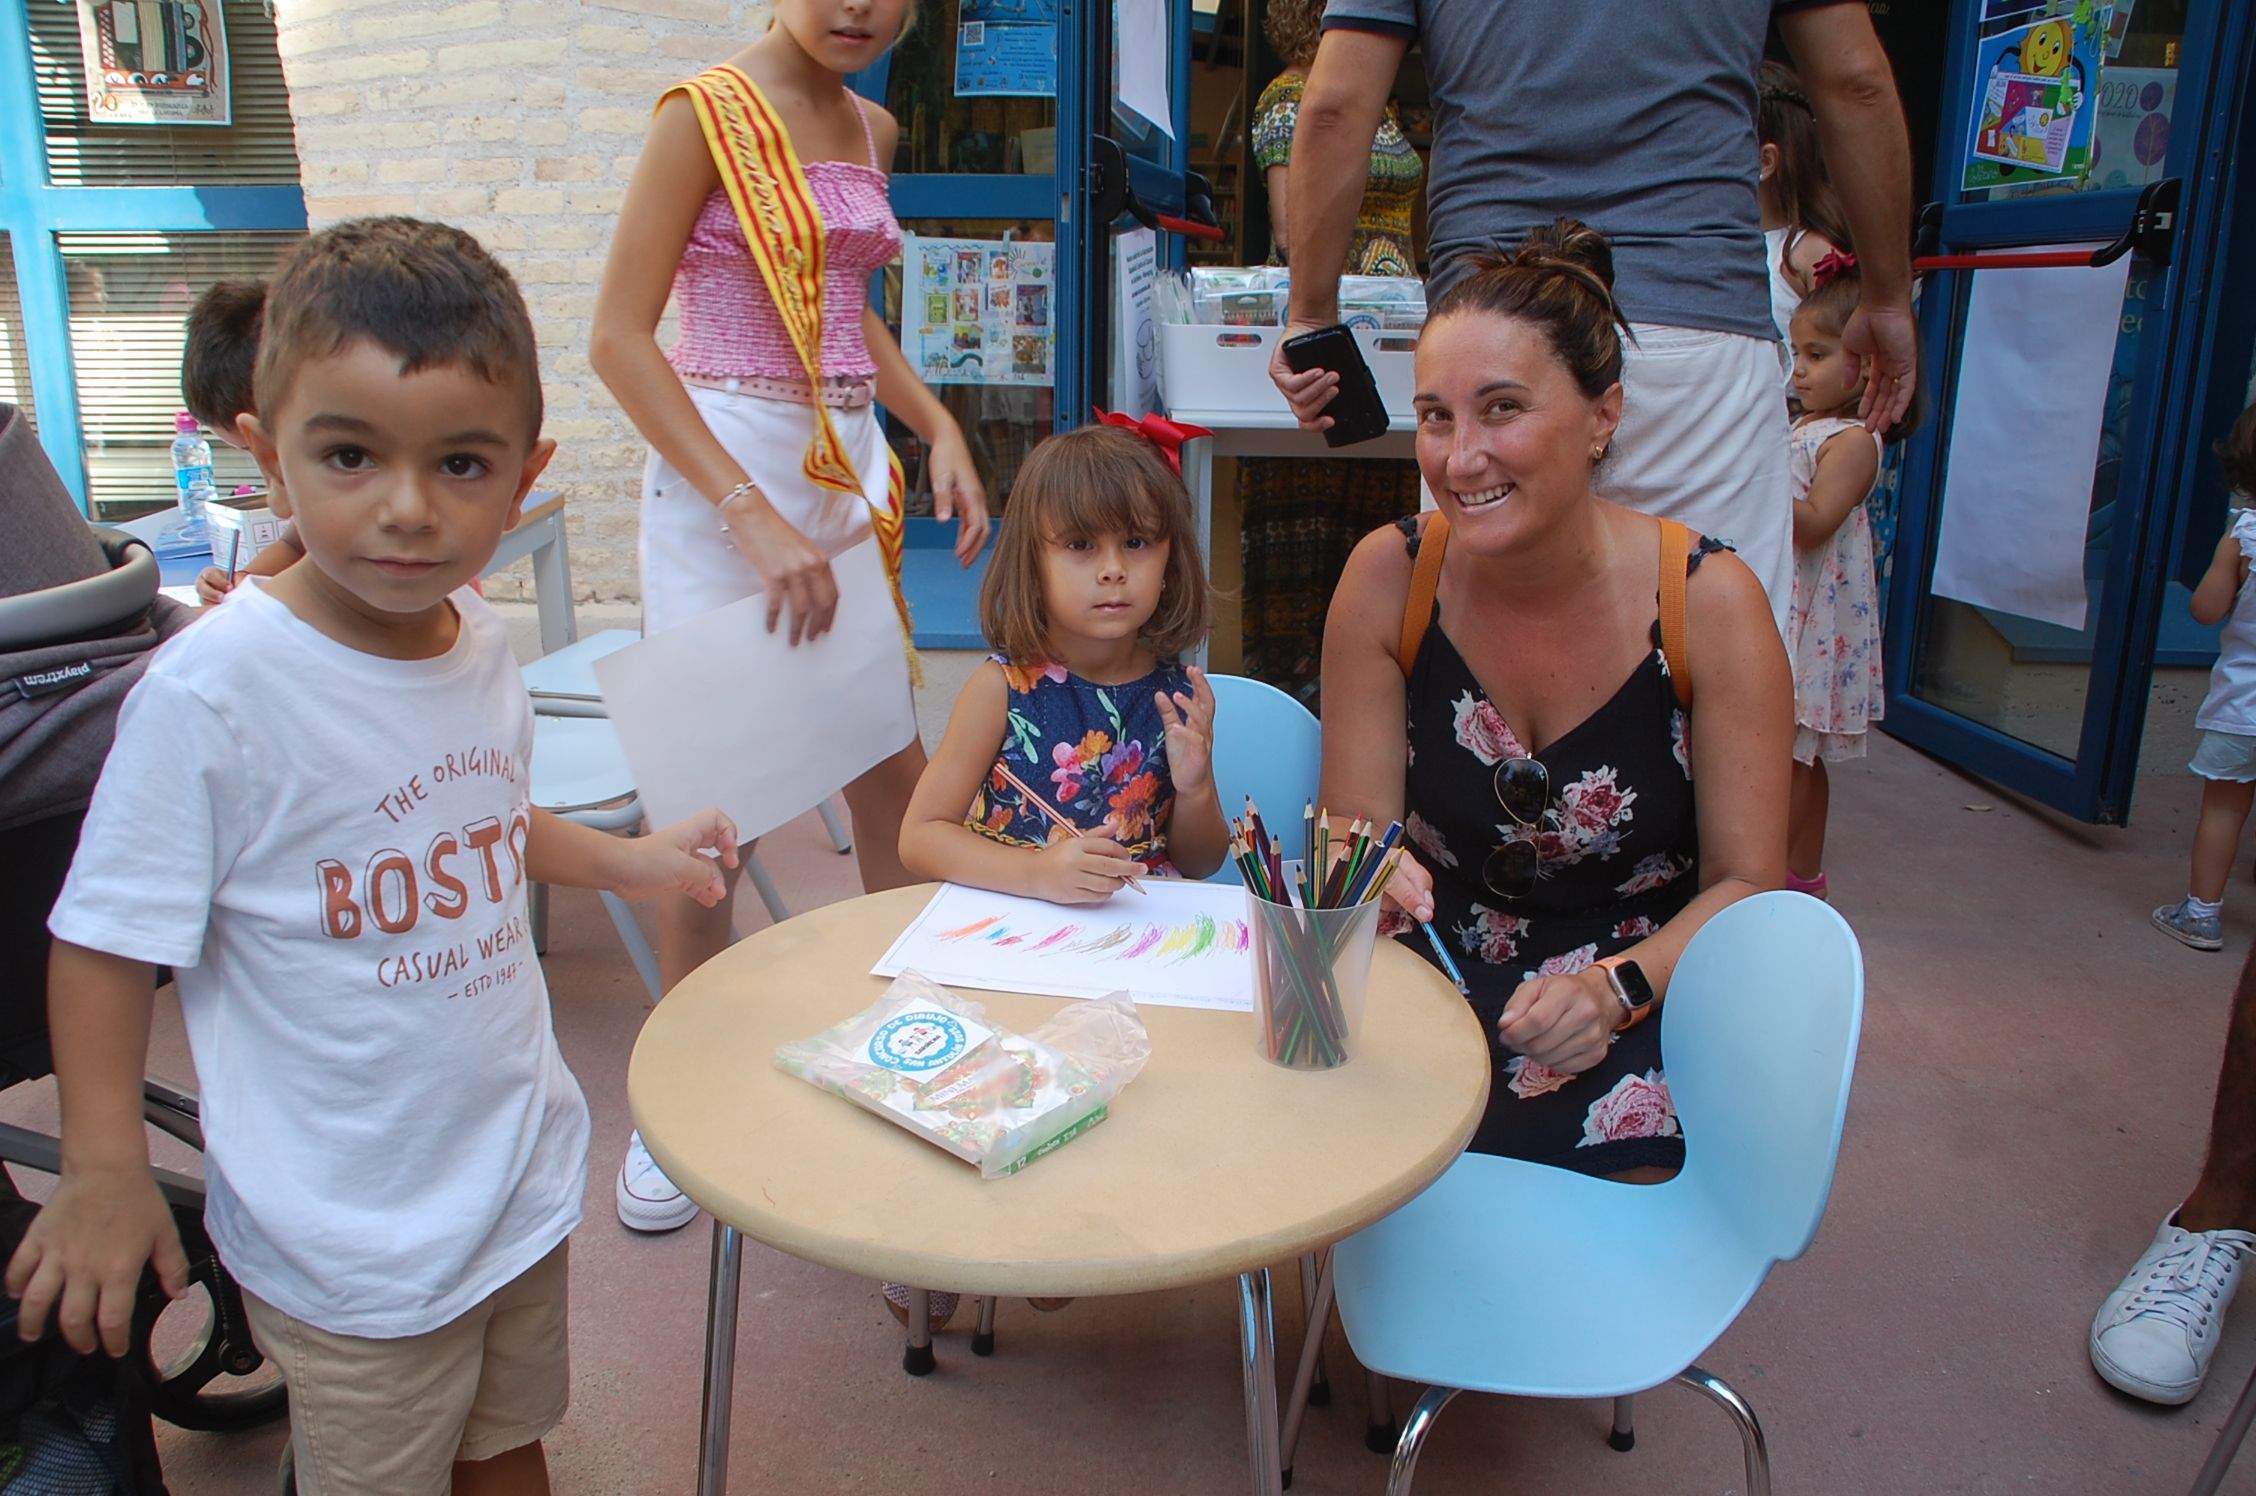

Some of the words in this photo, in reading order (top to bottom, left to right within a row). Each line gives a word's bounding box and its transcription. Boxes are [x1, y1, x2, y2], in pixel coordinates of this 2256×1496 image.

[23, 661, 92, 686] playxtrem
[375, 774, 428, 823] THE
[433, 746, 515, 783] ORIGINAL
[377, 944, 469, 988] CASUAL
[477, 916, 524, 960] WEAR
[464, 974, 493, 998] ESTD
[886, 1019, 903, 1029] DE
[905, 1012, 948, 1024] DIBUJO
